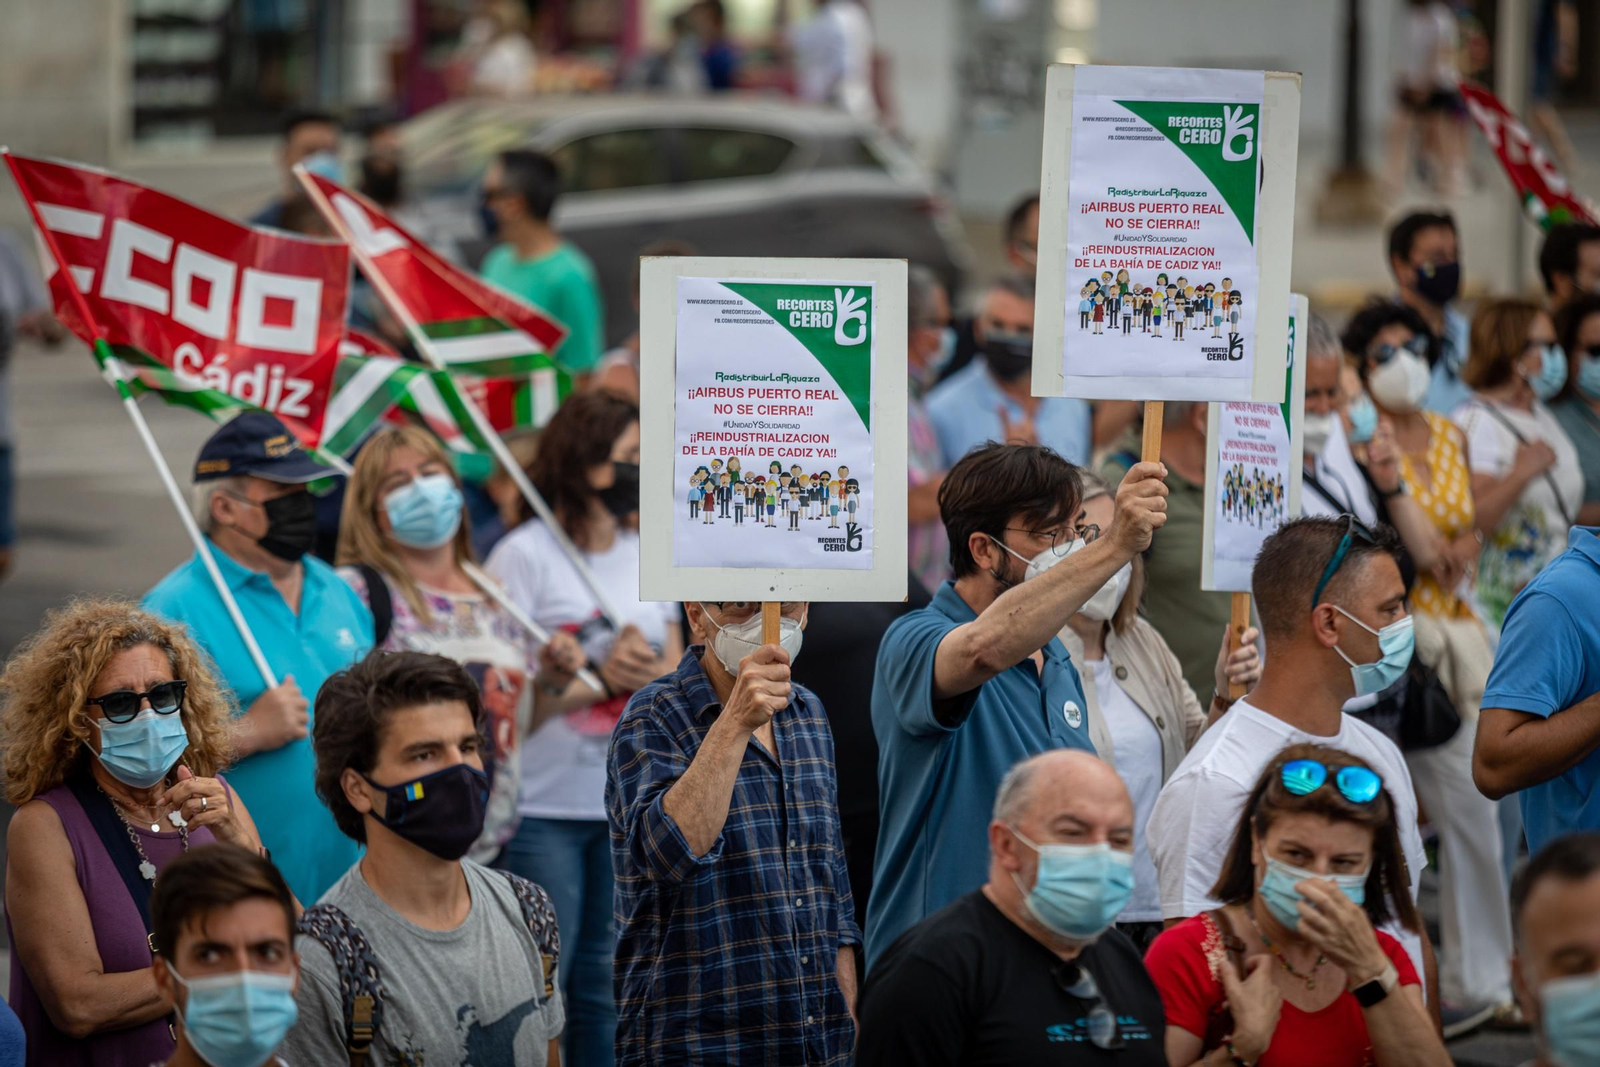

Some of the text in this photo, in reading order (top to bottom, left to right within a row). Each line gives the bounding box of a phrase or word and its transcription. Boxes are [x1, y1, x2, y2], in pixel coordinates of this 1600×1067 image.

[1168, 116, 1223, 128] RECORTES
[1179, 128, 1222, 144] CERO
[1108, 187, 1207, 199] RedistribuirLaRiqueza
[1081, 202, 1224, 214] ¡¡AIRBUS PUERTO REAL
[1105, 218, 1200, 230] NO SE CIERRA!!
[1082, 245, 1215, 256] ¡¡REINDUSTRIALIZACION
[1074, 257, 1221, 270] DE LA BAHÍA DE CADIZ YA!!
[776, 299, 834, 311] RECORTES
[789, 312, 833, 328] CERO
[1207, 353, 1227, 361] CERO
[172, 341, 314, 418] Cádiz
[715, 372, 820, 384] RedistribuirLaRiqueza
[688, 387, 839, 400] ¡¡AIRBUS PUERTO REAL
[714, 404, 813, 416] NO SE CIERRA!!
[690, 432, 830, 444] ¡¡REINDUSTRIALIZACION
[682, 444, 837, 458] DE LA BAHÍA DE CADIZ YA!!
[824, 544, 845, 552] CERO
